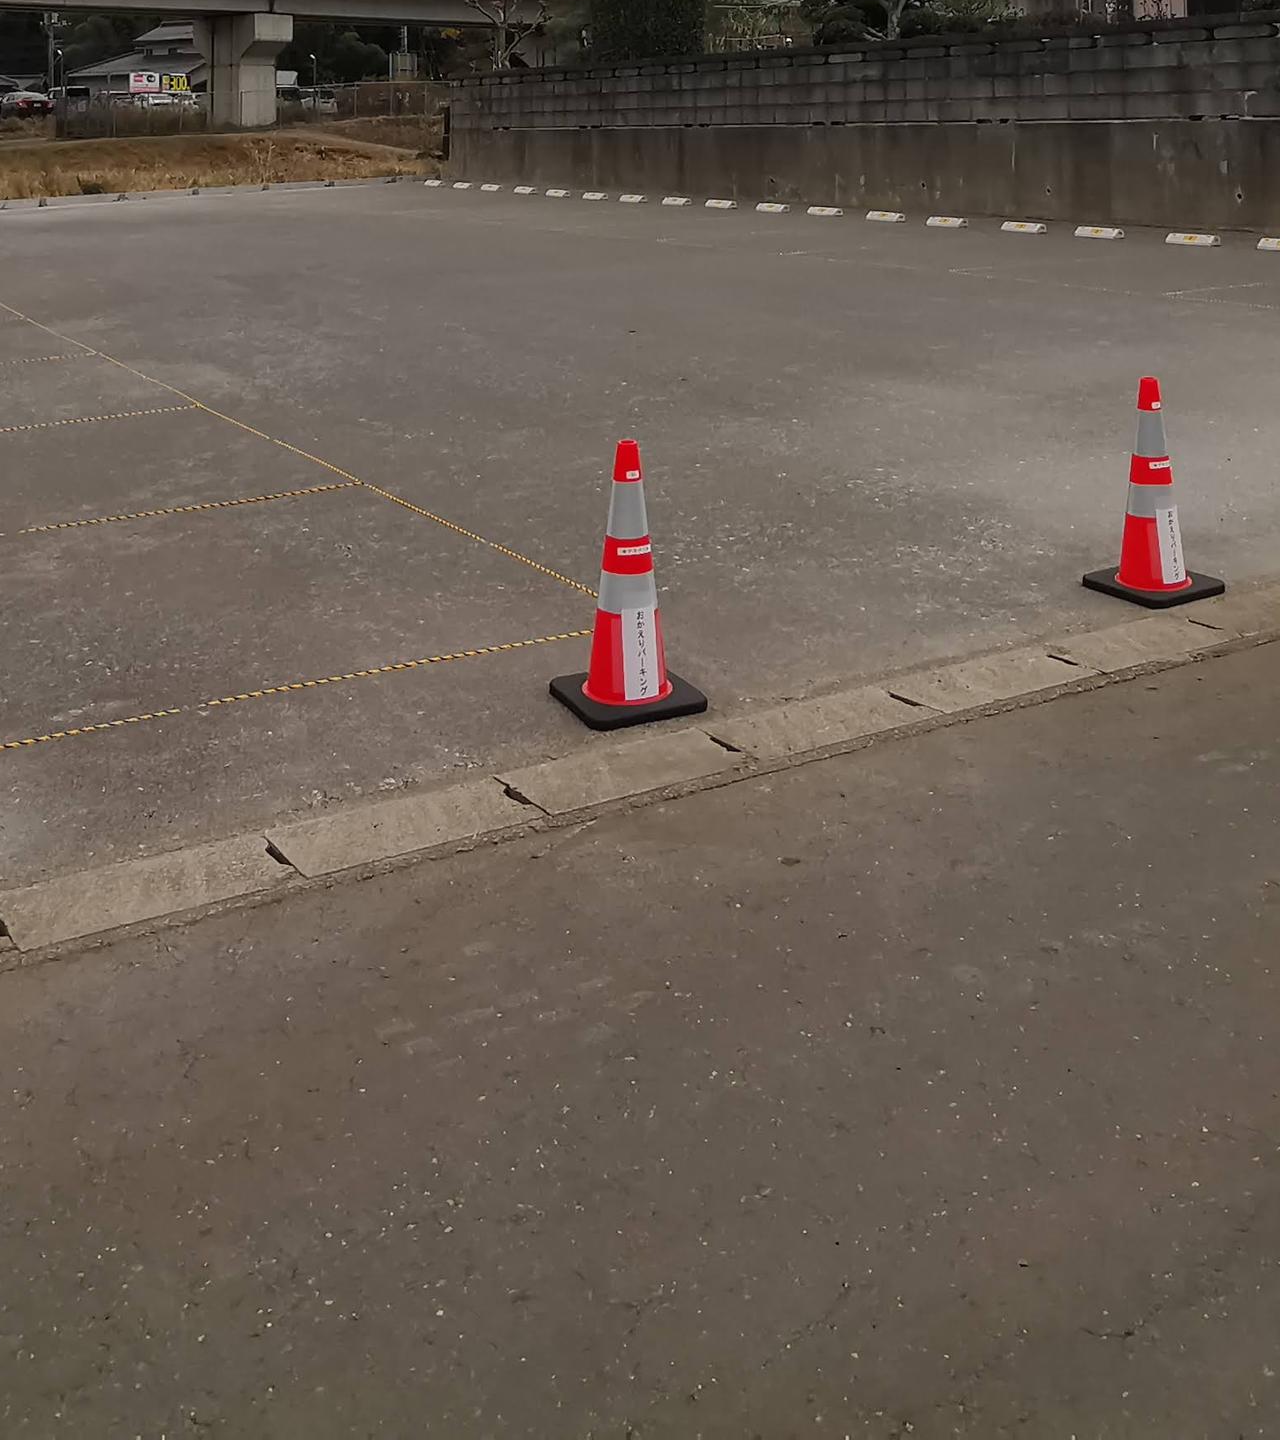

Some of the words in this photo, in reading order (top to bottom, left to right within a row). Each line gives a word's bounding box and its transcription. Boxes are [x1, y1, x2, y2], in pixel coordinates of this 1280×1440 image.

[635, 610, 649, 697] おかえりパーキング
